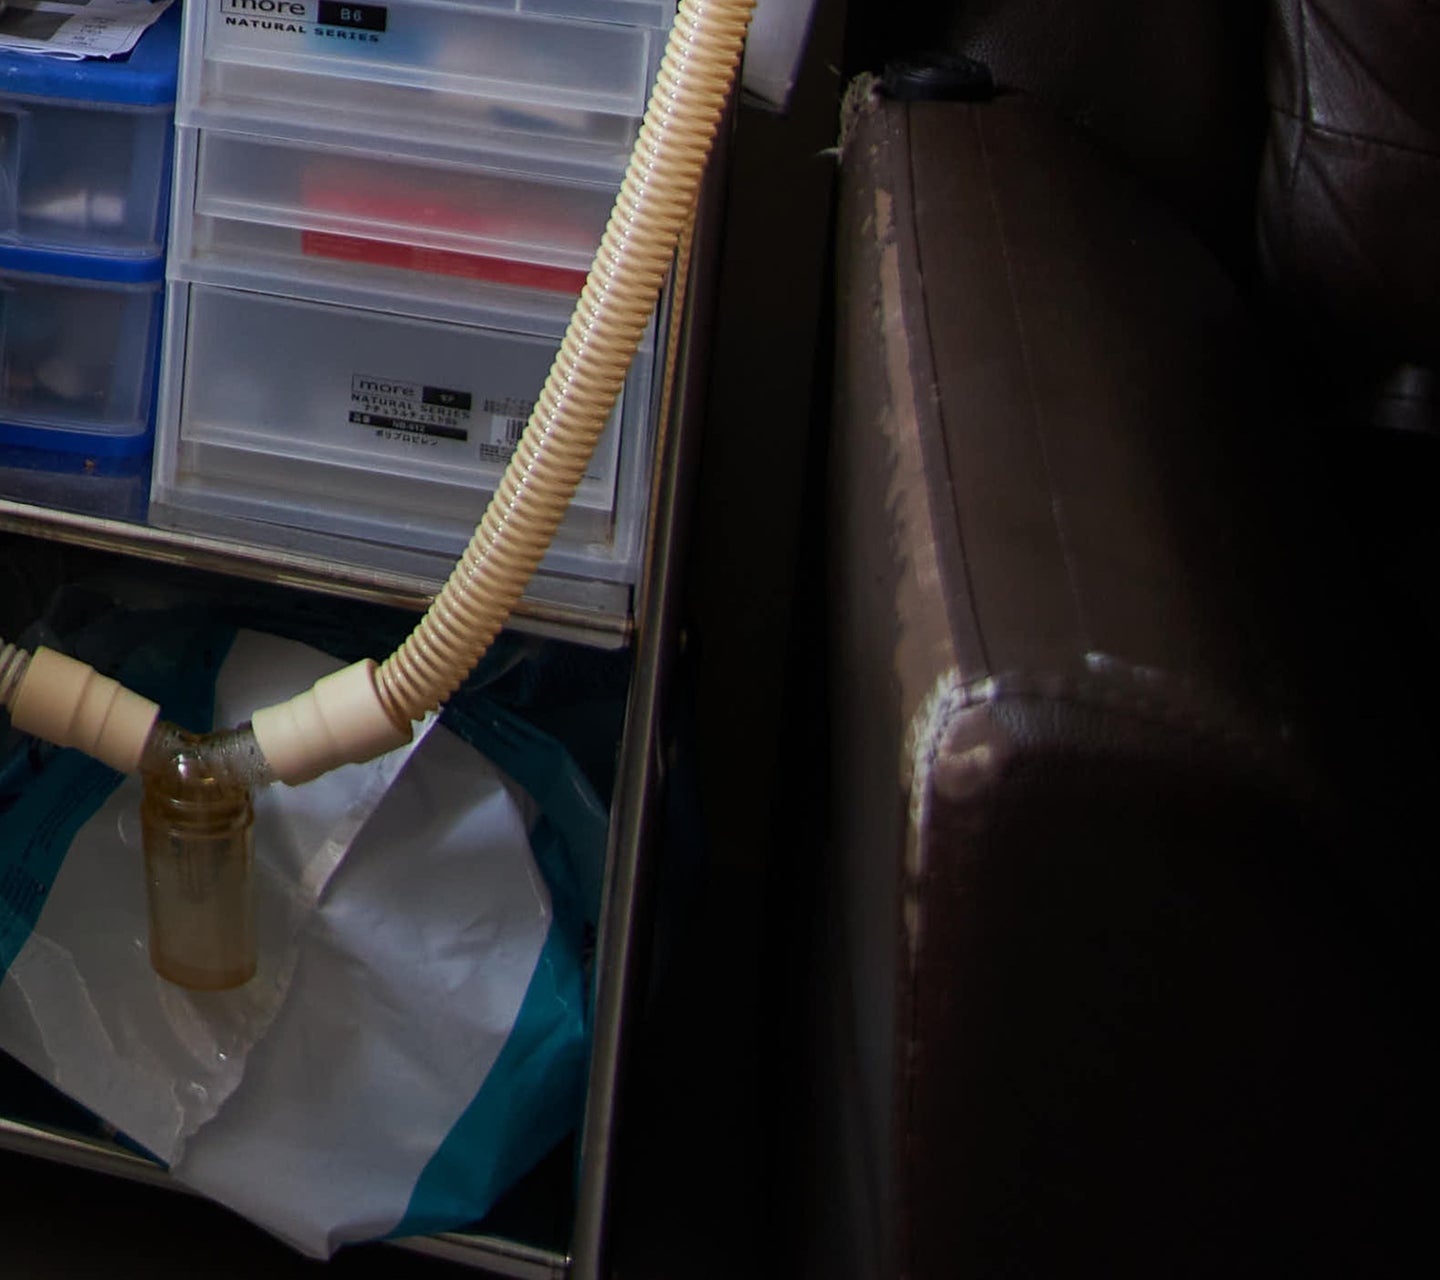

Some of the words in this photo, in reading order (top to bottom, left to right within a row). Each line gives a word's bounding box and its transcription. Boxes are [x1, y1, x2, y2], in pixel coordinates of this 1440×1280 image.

[340, 8, 363, 22] B6
[225, 16, 308, 34] NATURAL
[313, 27, 380, 43] SERIES
[359, 379, 416, 397] more
[351, 392, 414, 411] NATURAL
[420, 404, 472, 420] SERIES
